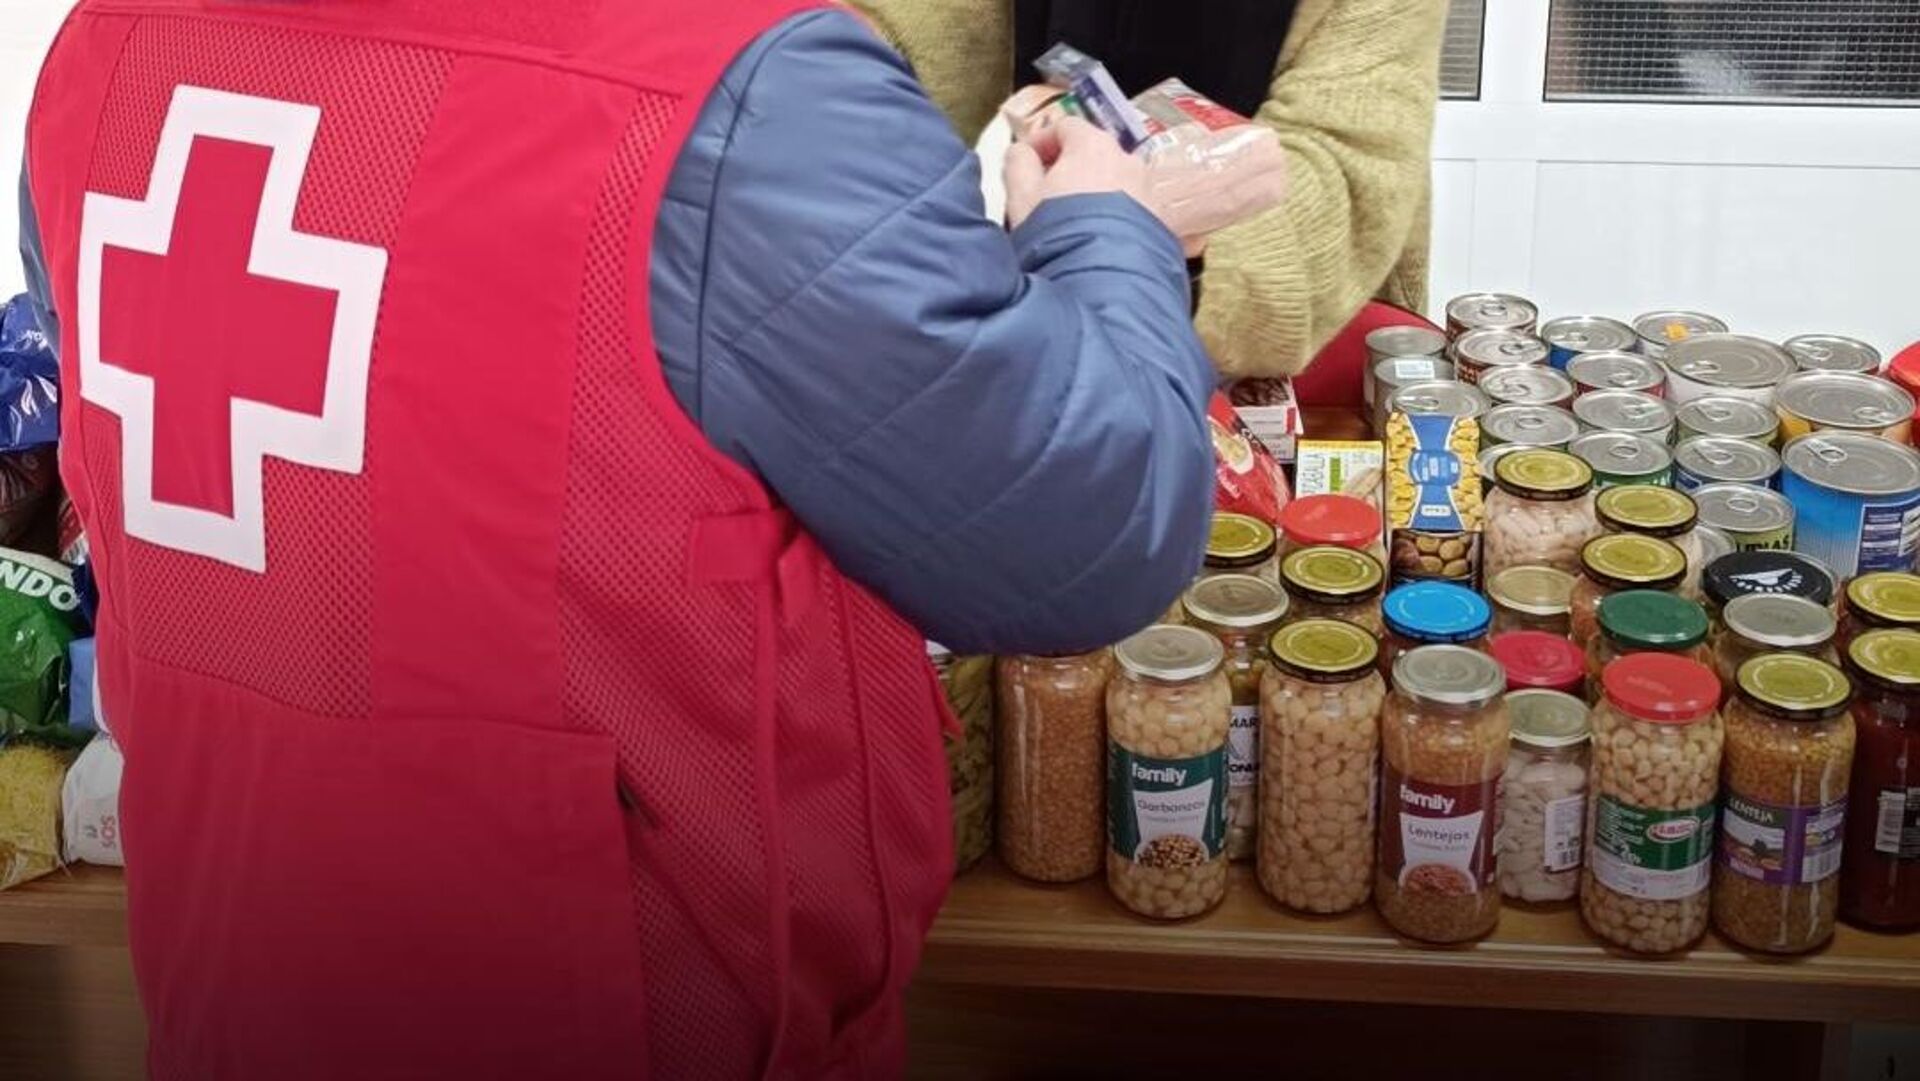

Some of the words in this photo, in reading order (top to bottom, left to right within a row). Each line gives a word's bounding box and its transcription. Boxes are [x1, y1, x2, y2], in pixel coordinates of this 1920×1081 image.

[1132, 762, 1188, 787] family
[1138, 799, 1205, 814] Garbanzos
[1400, 784, 1455, 814] family
[100, 815, 116, 849] SOS
[1408, 823, 1470, 844] Lentejas
